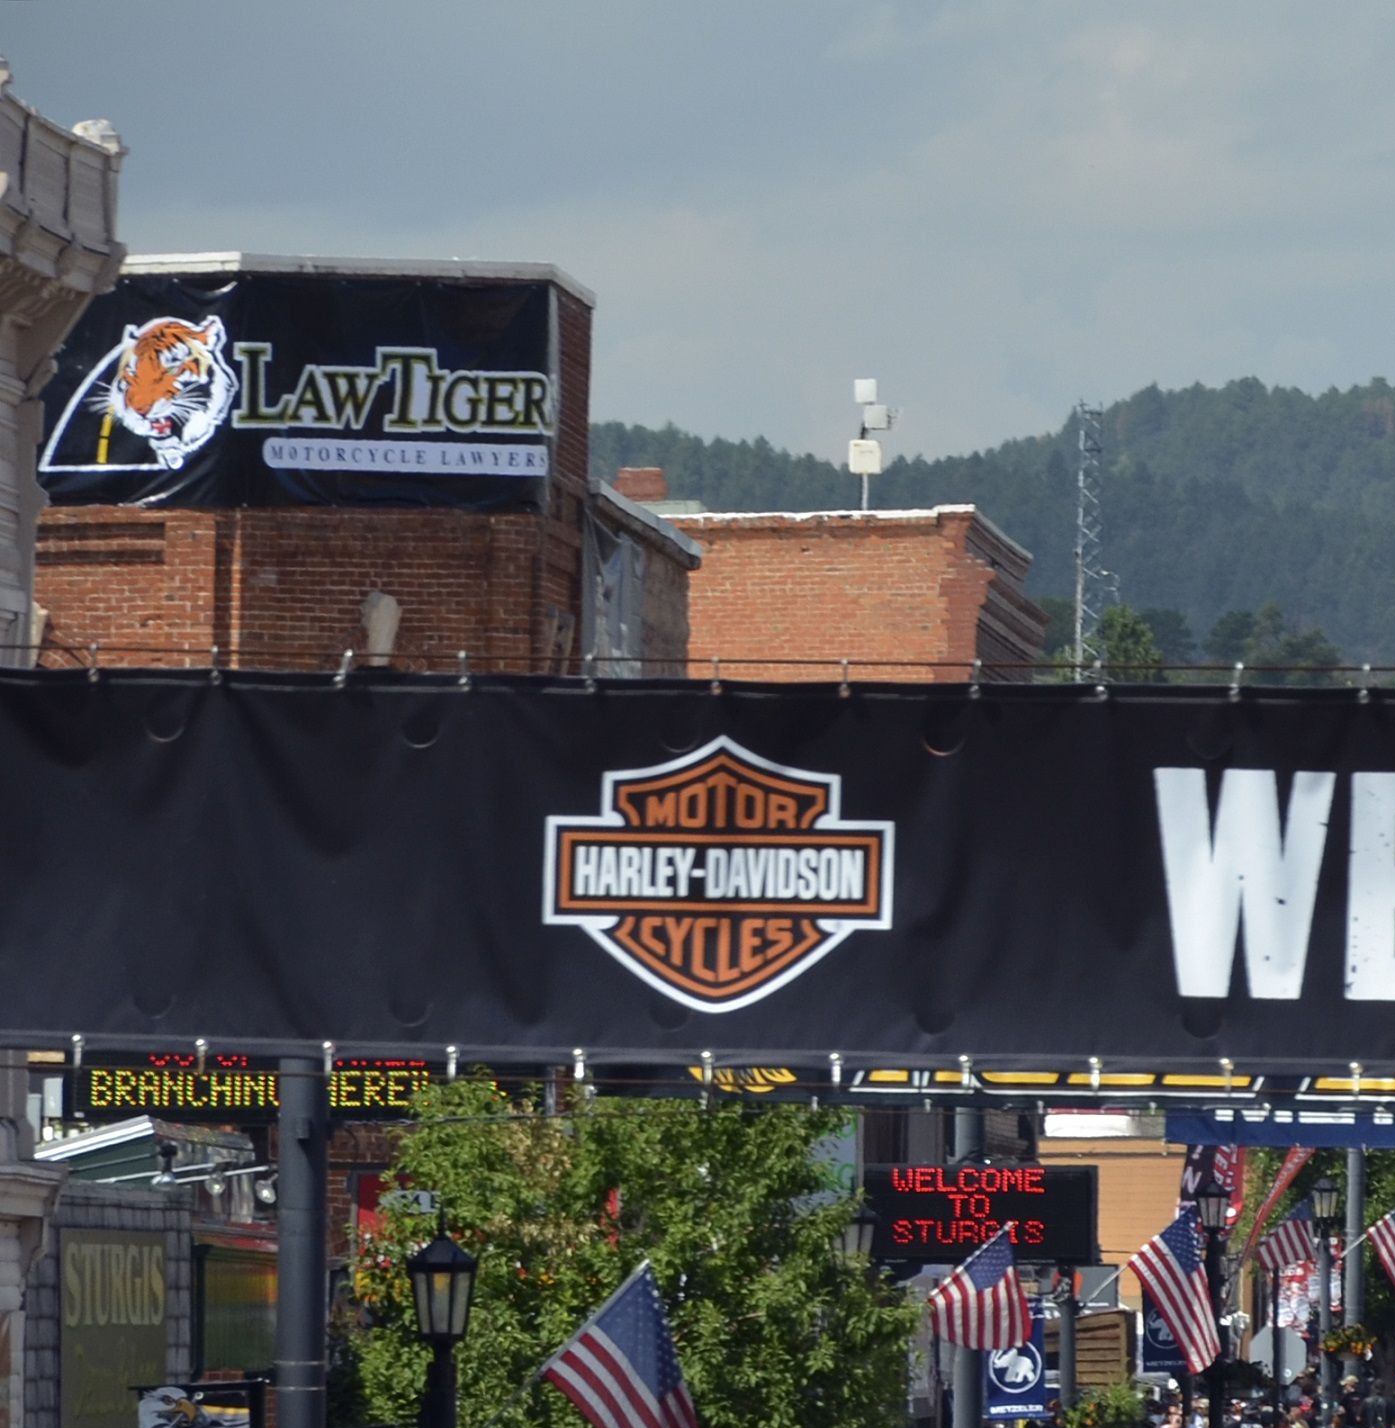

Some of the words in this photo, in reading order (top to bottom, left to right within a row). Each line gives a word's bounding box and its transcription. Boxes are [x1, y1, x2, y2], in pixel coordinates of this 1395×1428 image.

[271, 445, 427, 464] MOTORCYCLE
[646, 771, 799, 829] MOTOR
[574, 845, 864, 900] HARLEY-DAVIDSON
[640, 916, 794, 982] CYCLES
[892, 1168, 1045, 1193] WELCOME
[947, 1194, 990, 1218] TO
[893, 1220, 1045, 1244] STURGIS
[65, 1242, 165, 1327] STURGIS
